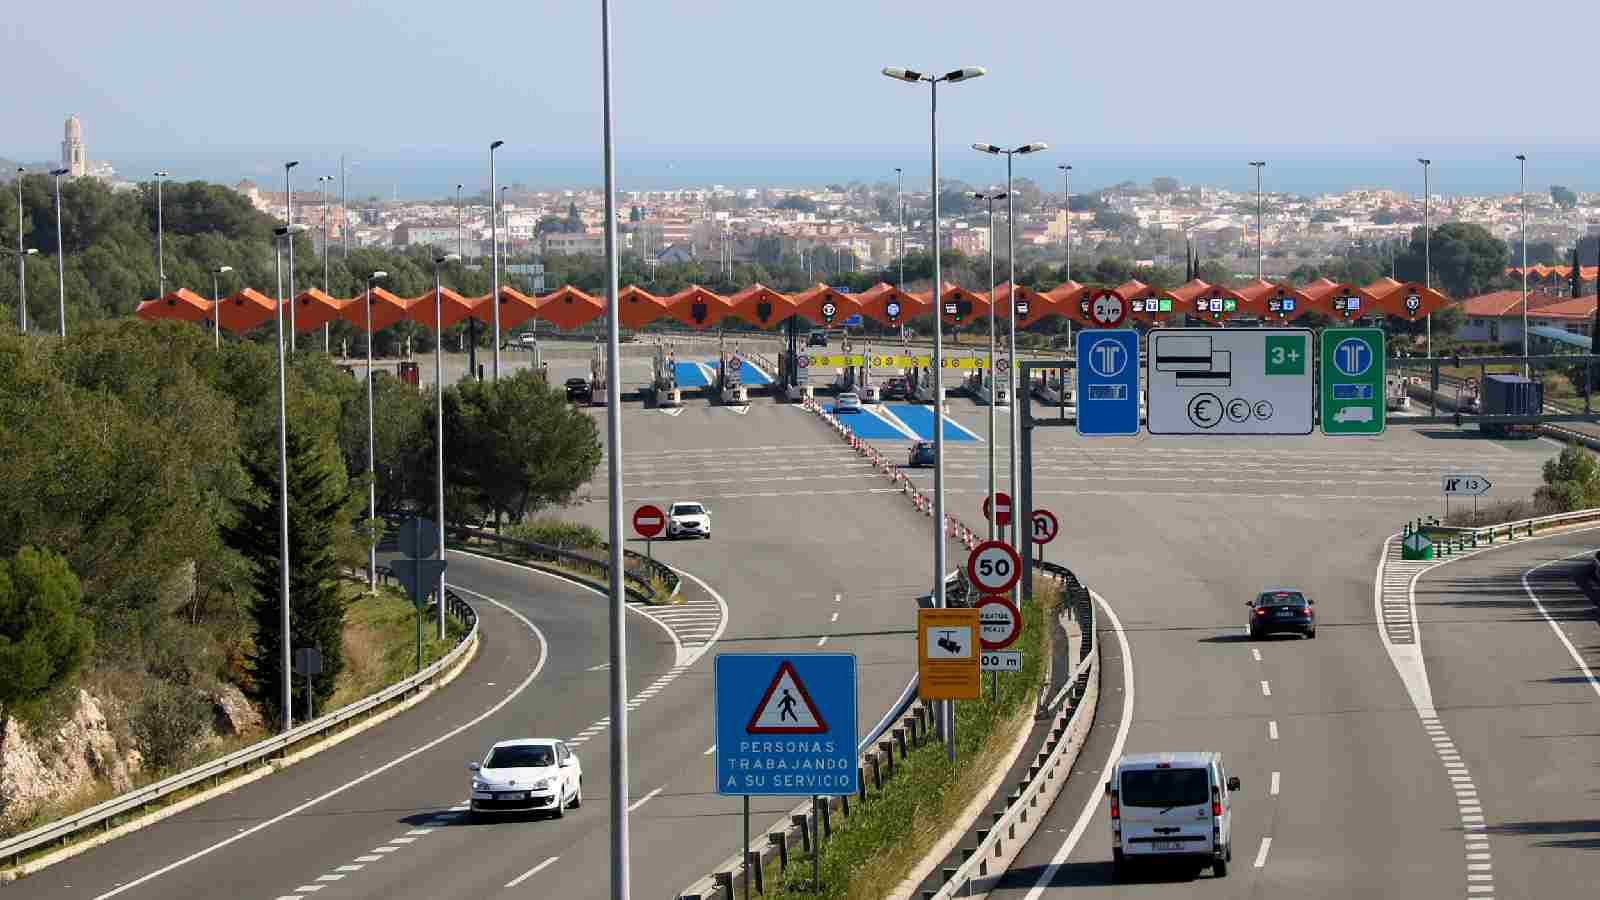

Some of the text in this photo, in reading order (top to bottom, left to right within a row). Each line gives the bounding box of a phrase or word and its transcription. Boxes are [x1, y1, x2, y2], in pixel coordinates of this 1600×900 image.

[1271, 347, 1300, 365] 3+
[1465, 479, 1479, 490] 13
[980, 559, 1010, 577] 50
[981, 655, 999, 666] 00
[1007, 658, 1017, 666] m
[740, 741, 835, 753] PERSONAS
[728, 758, 848, 770] TRABAJANDO
[727, 775, 849, 786] A SU SERVICIO
